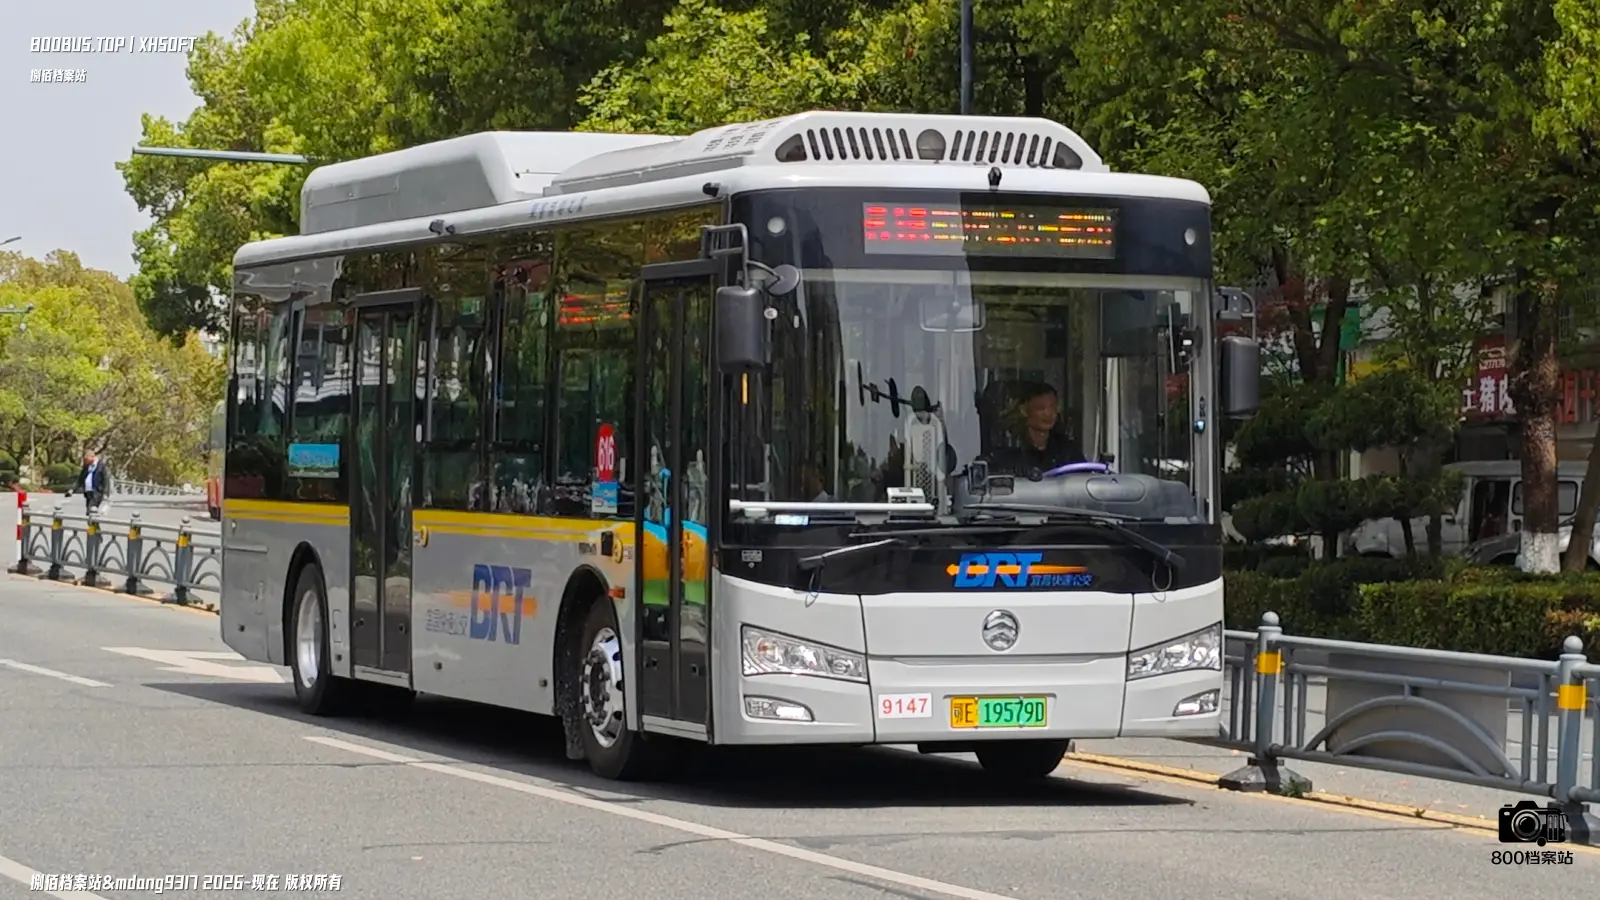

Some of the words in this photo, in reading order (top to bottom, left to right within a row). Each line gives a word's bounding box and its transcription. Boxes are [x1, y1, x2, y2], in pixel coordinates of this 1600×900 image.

[598, 436, 615, 471] 616
[955, 552, 1043, 587] BRT
[470, 564, 531, 645] BRT
[882, 698, 928, 714] 9147
[984, 701, 1044, 723] 19579D
